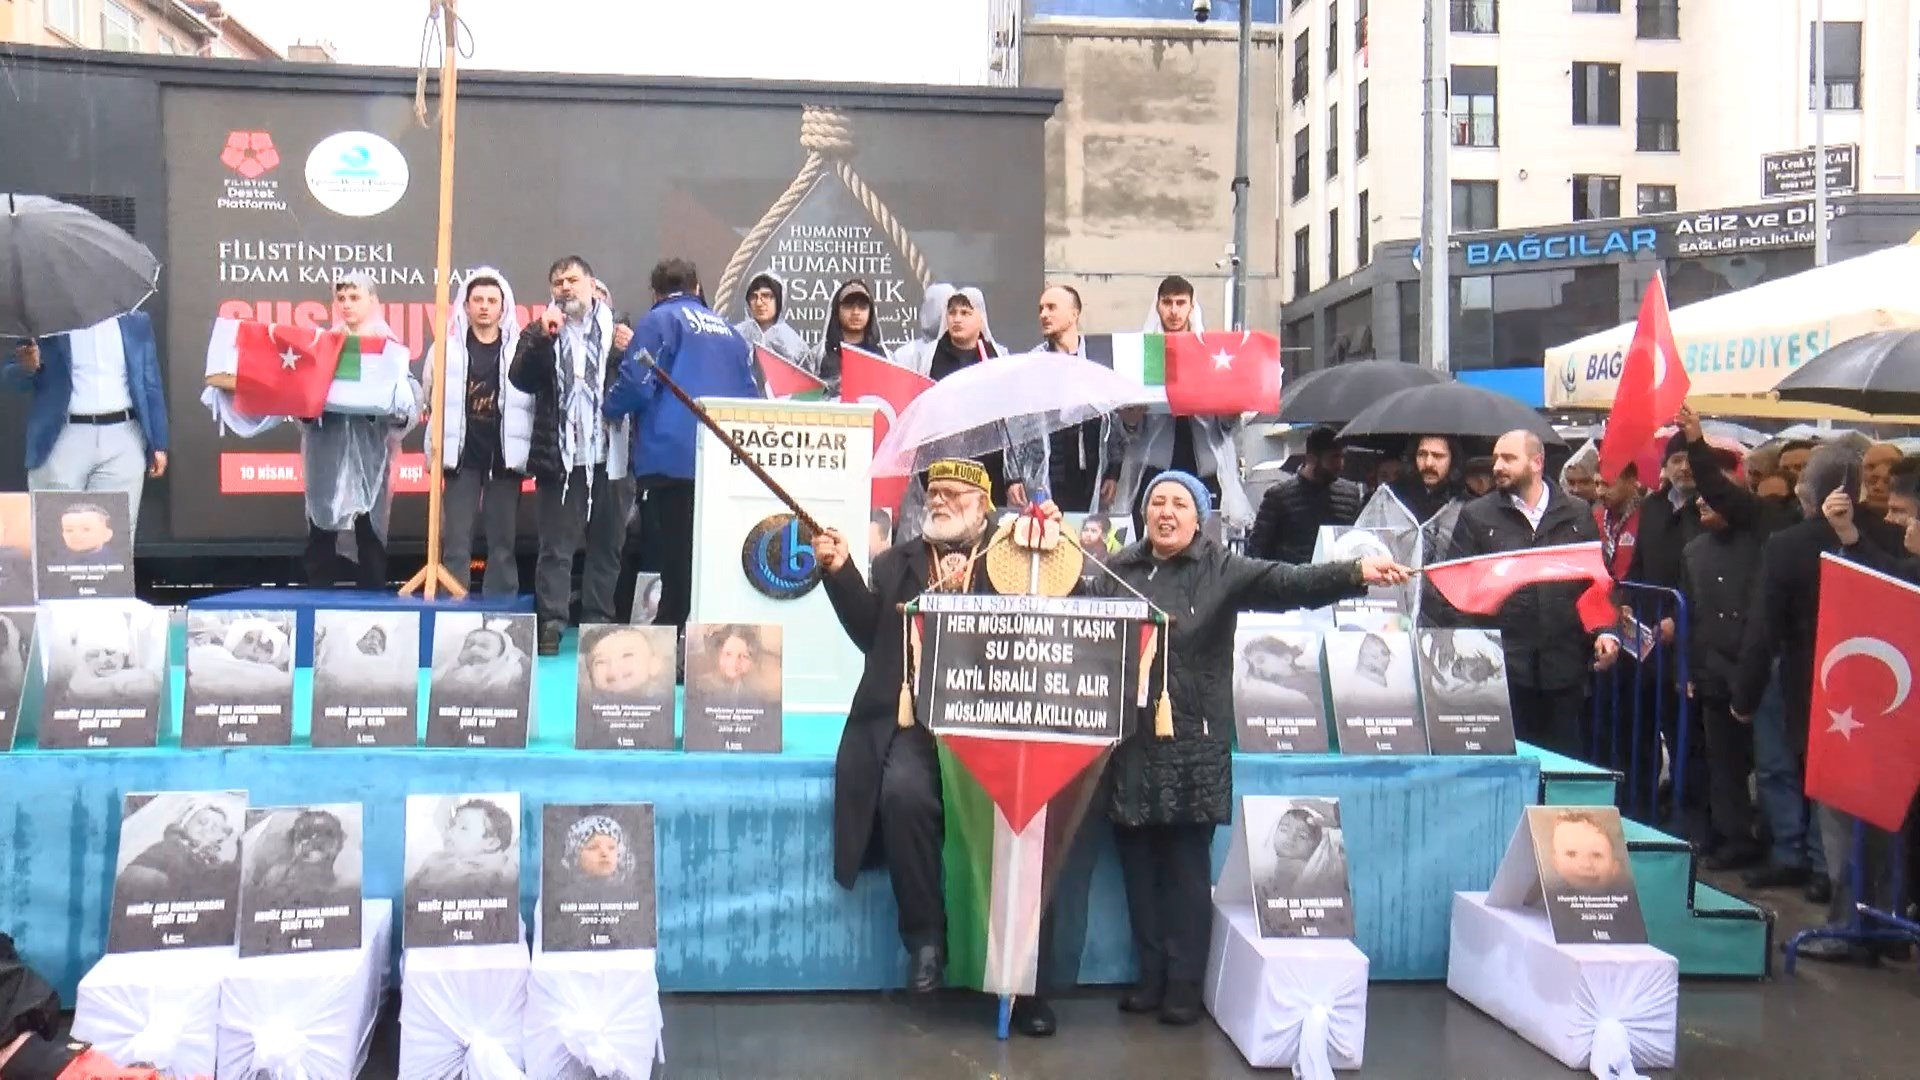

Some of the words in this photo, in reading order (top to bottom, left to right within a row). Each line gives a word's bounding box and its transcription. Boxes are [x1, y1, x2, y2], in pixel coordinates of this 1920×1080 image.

[217, 198, 287, 210] Platformu
[228, 187, 275, 198] Destek
[790, 225, 872, 238] HUMANITY
[1675, 213, 1739, 236] AĞIZ
[1745, 212, 1779, 229] ve
[219, 239, 393, 263] FİLİSTİN'DEKİ
[778, 239, 884, 254] MENSCHHEIT
[1467, 226, 1657, 266] BAĞCILAR
[1678, 237, 1737, 253] SAĞLIĞI
[1740, 229, 1831, 247] POLİKLİNİİ
[220, 261, 290, 283] İDAM
[771, 252, 892, 274] HUMANITÉ
[731, 424, 847, 450] BAĞCILAR
[240, 467, 254, 480] 10
[947, 614, 975, 633] HER
[978, 612, 1054, 637] MÜSLÜMAN
[1062, 619, 1069, 637] 1
[1073, 619, 1116, 643] KAŞIK
[985, 641, 1009, 660] SU
[1013, 637, 1073, 664] DÖKSE
[945, 665, 985, 691] KATİL
[989, 665, 1037, 693] İSRAİLİ
[1044, 672, 1070, 695] SEL
[1076, 674, 1109, 697] ALIR
[944, 699, 1032, 725] MÜSLÜMANLAR
[1034, 702, 1072, 726] AKILLI
[1074, 708, 1107, 729] OLUN
